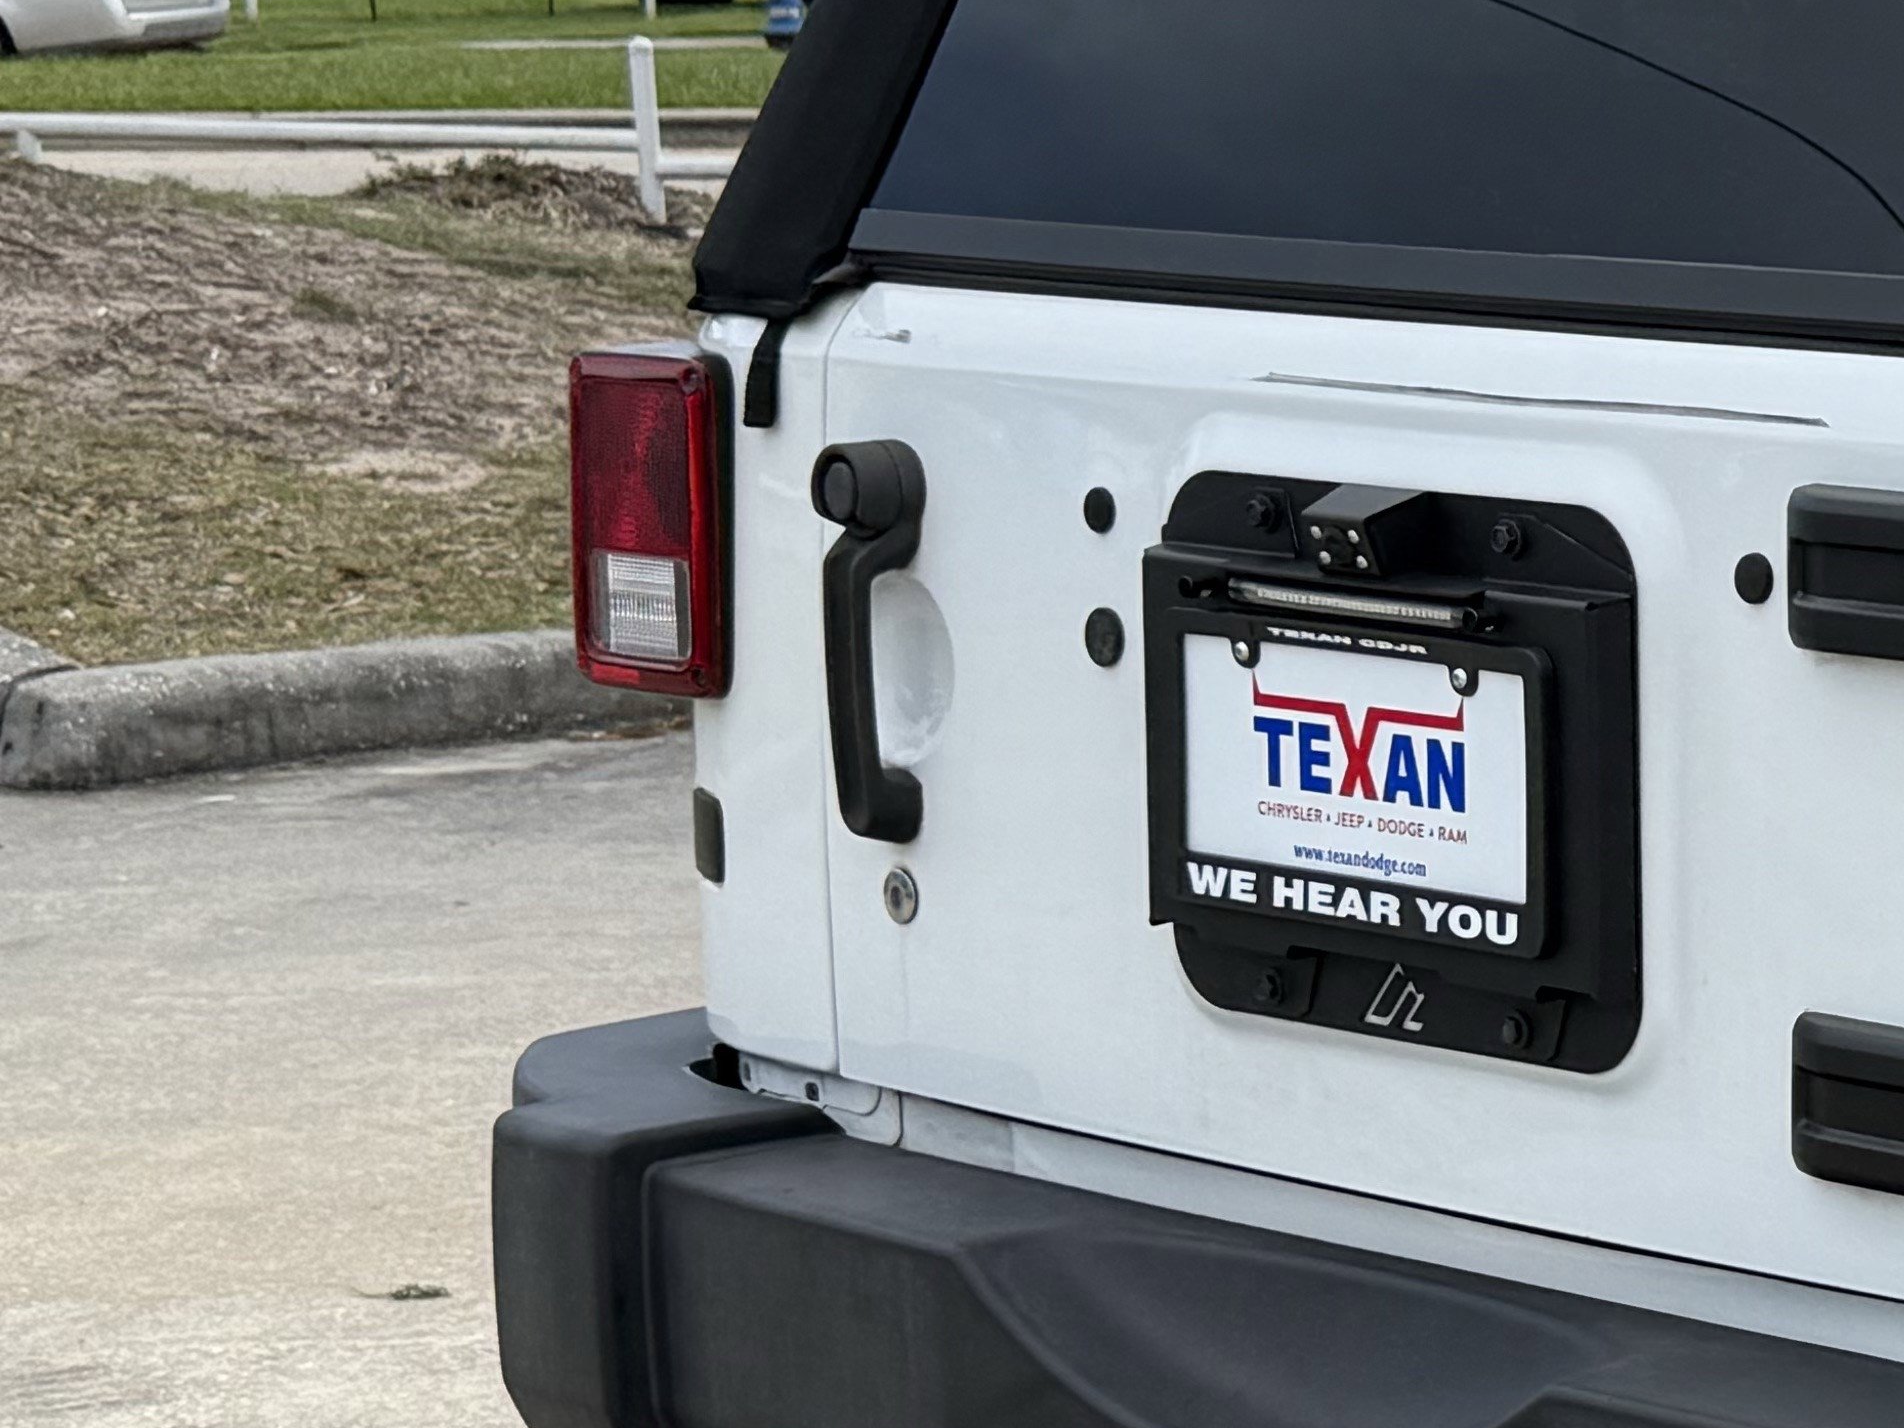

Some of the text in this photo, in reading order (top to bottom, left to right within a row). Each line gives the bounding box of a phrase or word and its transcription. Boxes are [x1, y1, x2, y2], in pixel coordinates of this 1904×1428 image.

[1266, 626, 1352, 645] TEXAN
[1252, 690, 1465, 813] TEXAN
[1257, 800, 1468, 844] CHRYSLER JEEP DODGE RAM
[1293, 844, 1427, 877] www.texandodge.com
[1187, 861, 1519, 946] WE HEAR YOU
